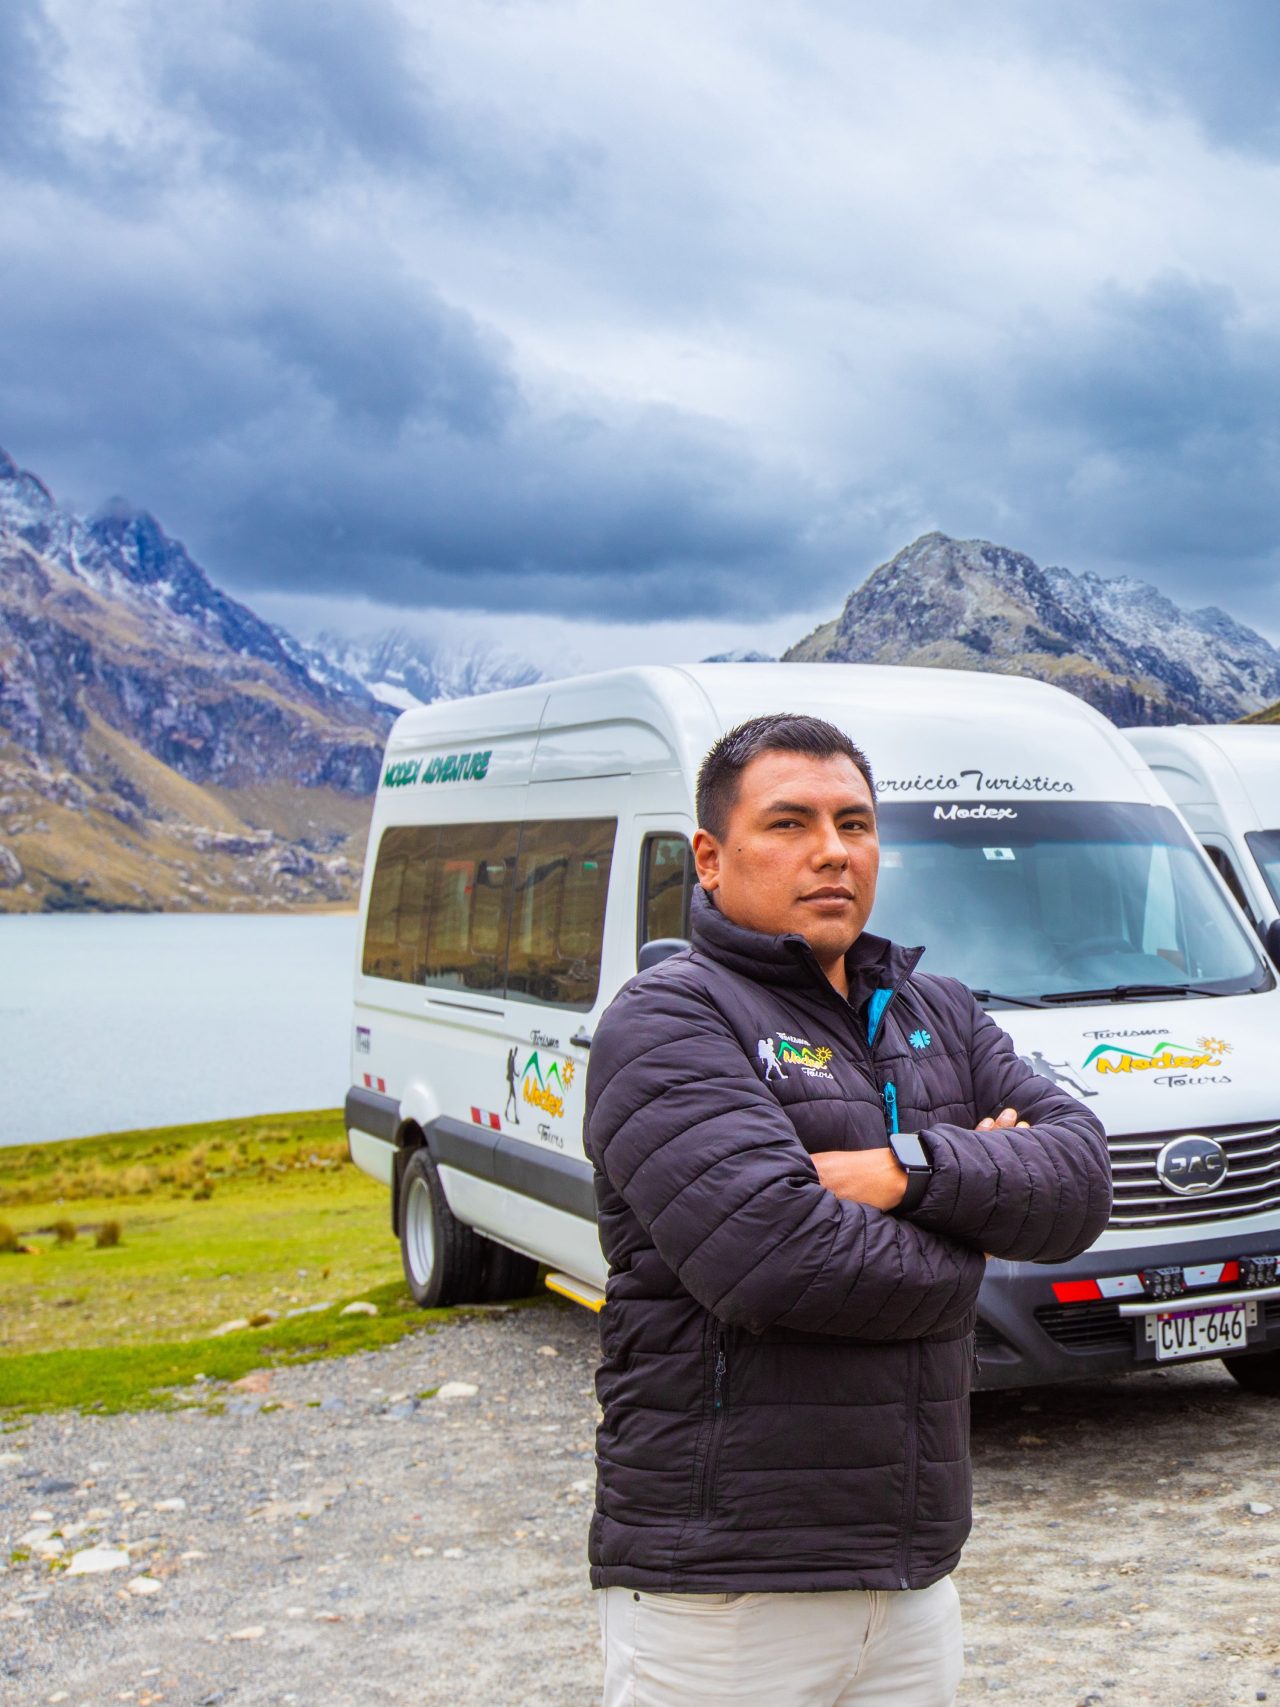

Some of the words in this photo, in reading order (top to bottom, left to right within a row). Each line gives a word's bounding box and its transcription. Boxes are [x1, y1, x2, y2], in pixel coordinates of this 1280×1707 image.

[421, 750, 492, 784] ADVENTURE
[874, 774, 960, 792] ervicio
[960, 770, 1075, 793] Turistico
[933, 804, 1018, 820] Modex
[1082, 1027, 1171, 1041] Turismo
[801, 1066, 835, 1080] Tours
[1095, 1051, 1223, 1075] Modex
[1153, 1073, 1233, 1089] Tours
[523, 1075, 565, 1119] Modex
[1161, 1309, 1243, 1350] CVI-646
